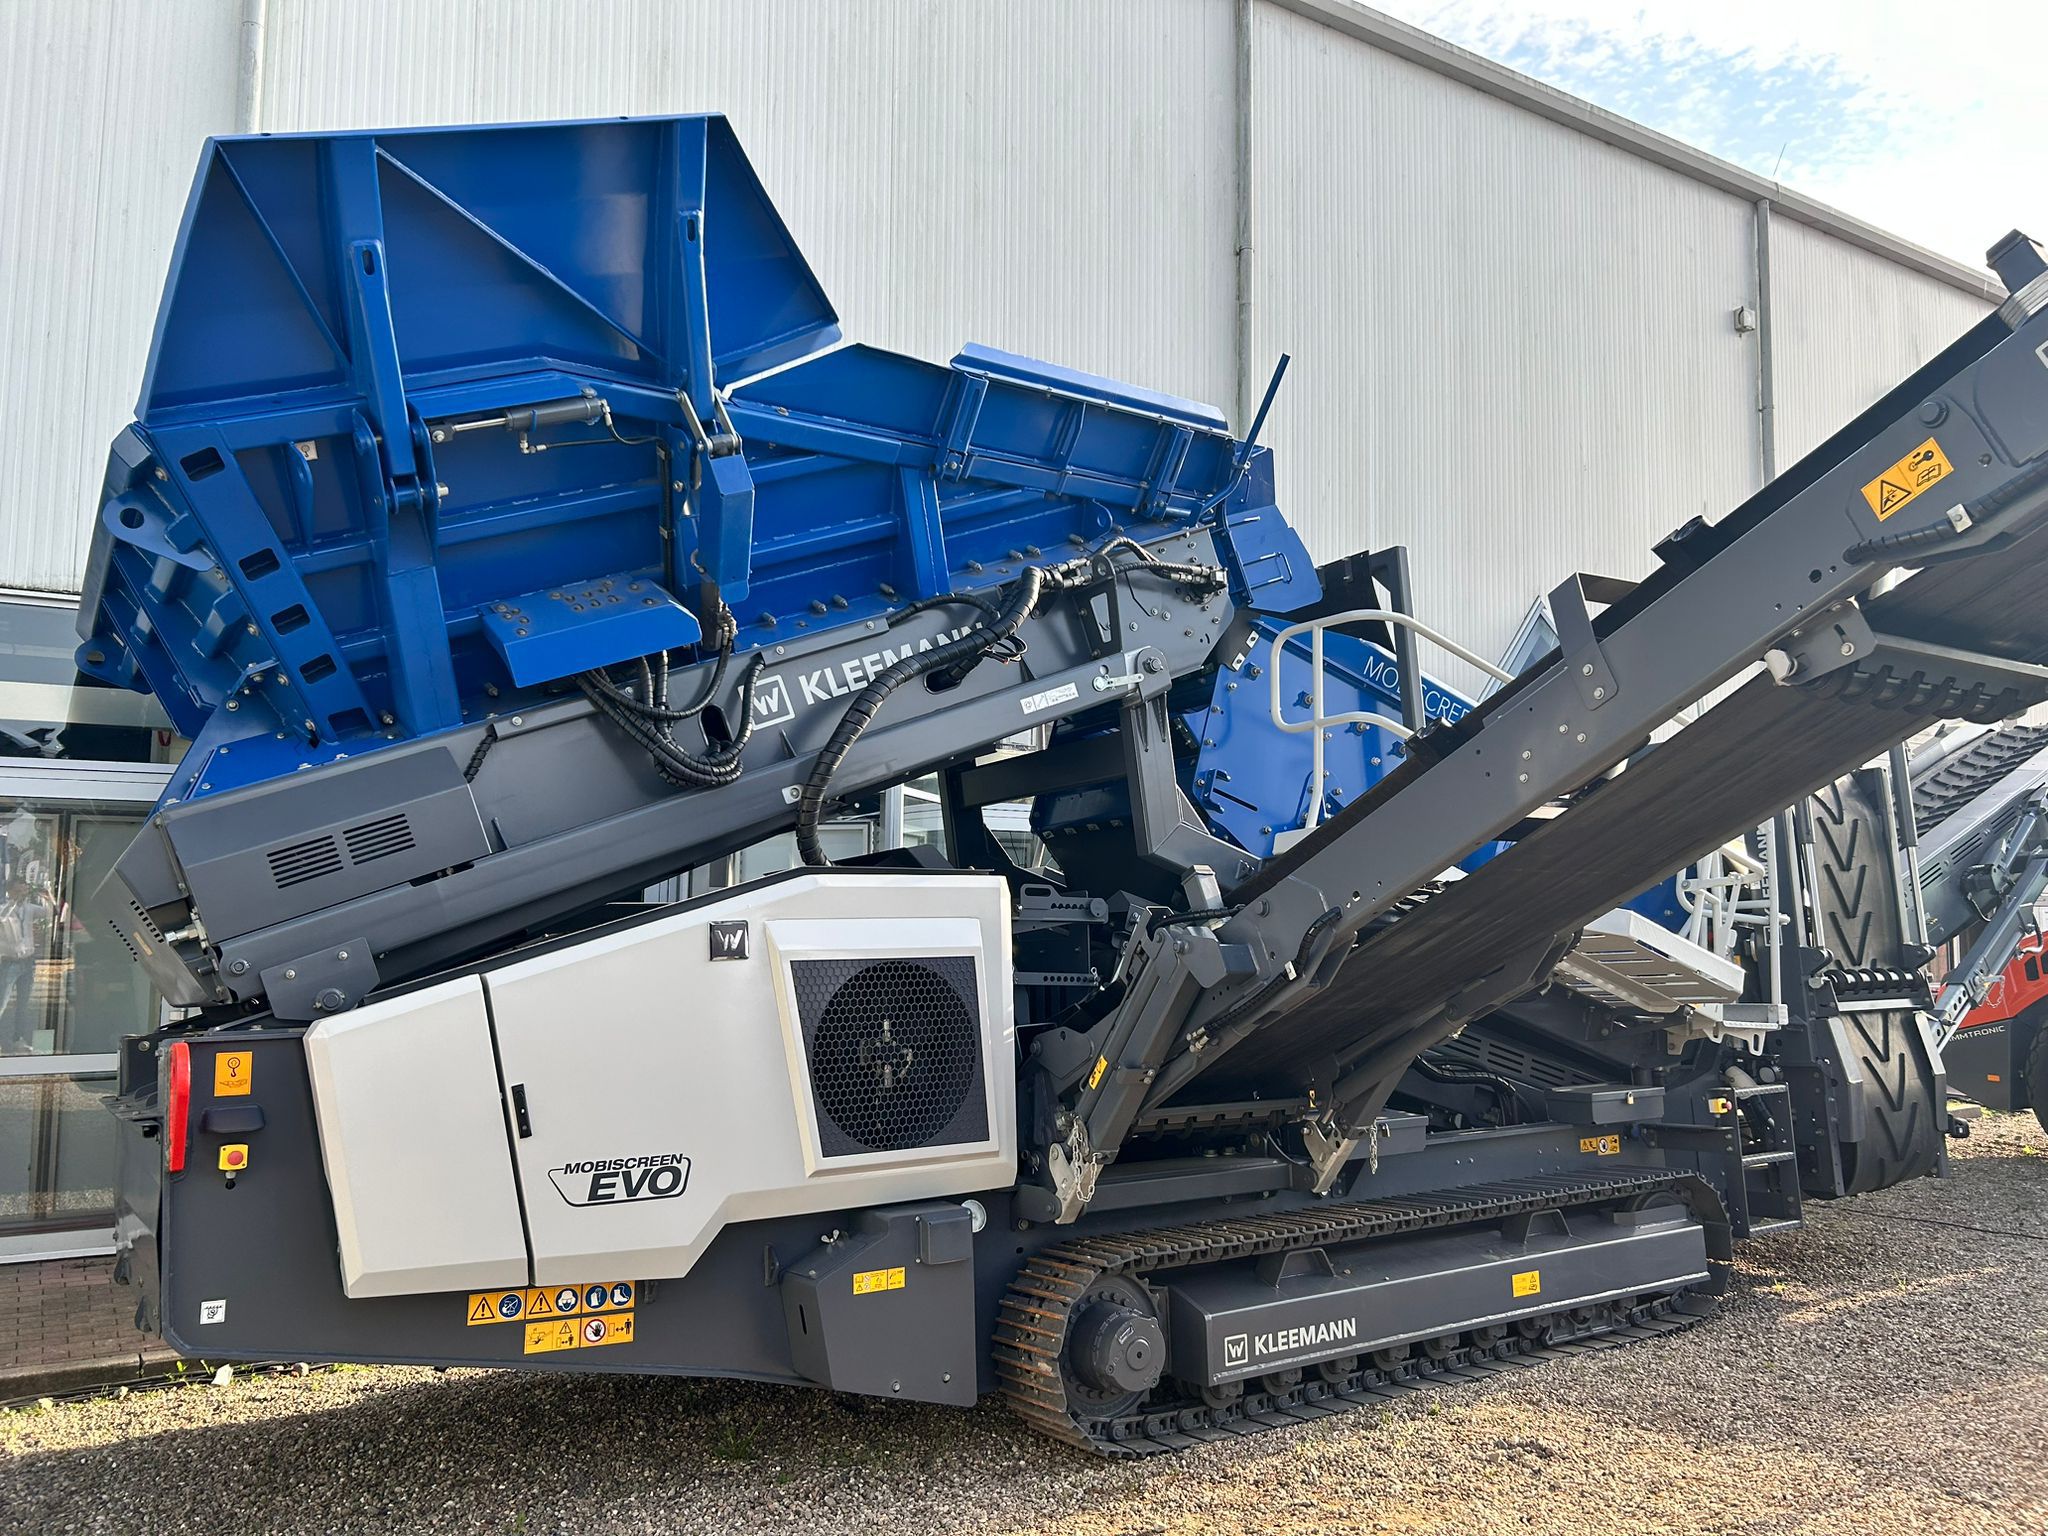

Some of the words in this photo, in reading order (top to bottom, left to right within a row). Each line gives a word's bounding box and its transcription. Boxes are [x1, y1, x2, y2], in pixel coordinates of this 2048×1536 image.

[798, 621, 984, 706] KLEEM
[1949, 1025, 2006, 1042] MMTRONIC
[563, 1153, 684, 1175] MOBISCREEN
[587, 1165, 682, 1202] EVO
[1254, 1317, 1357, 1356] KLEEMANN
